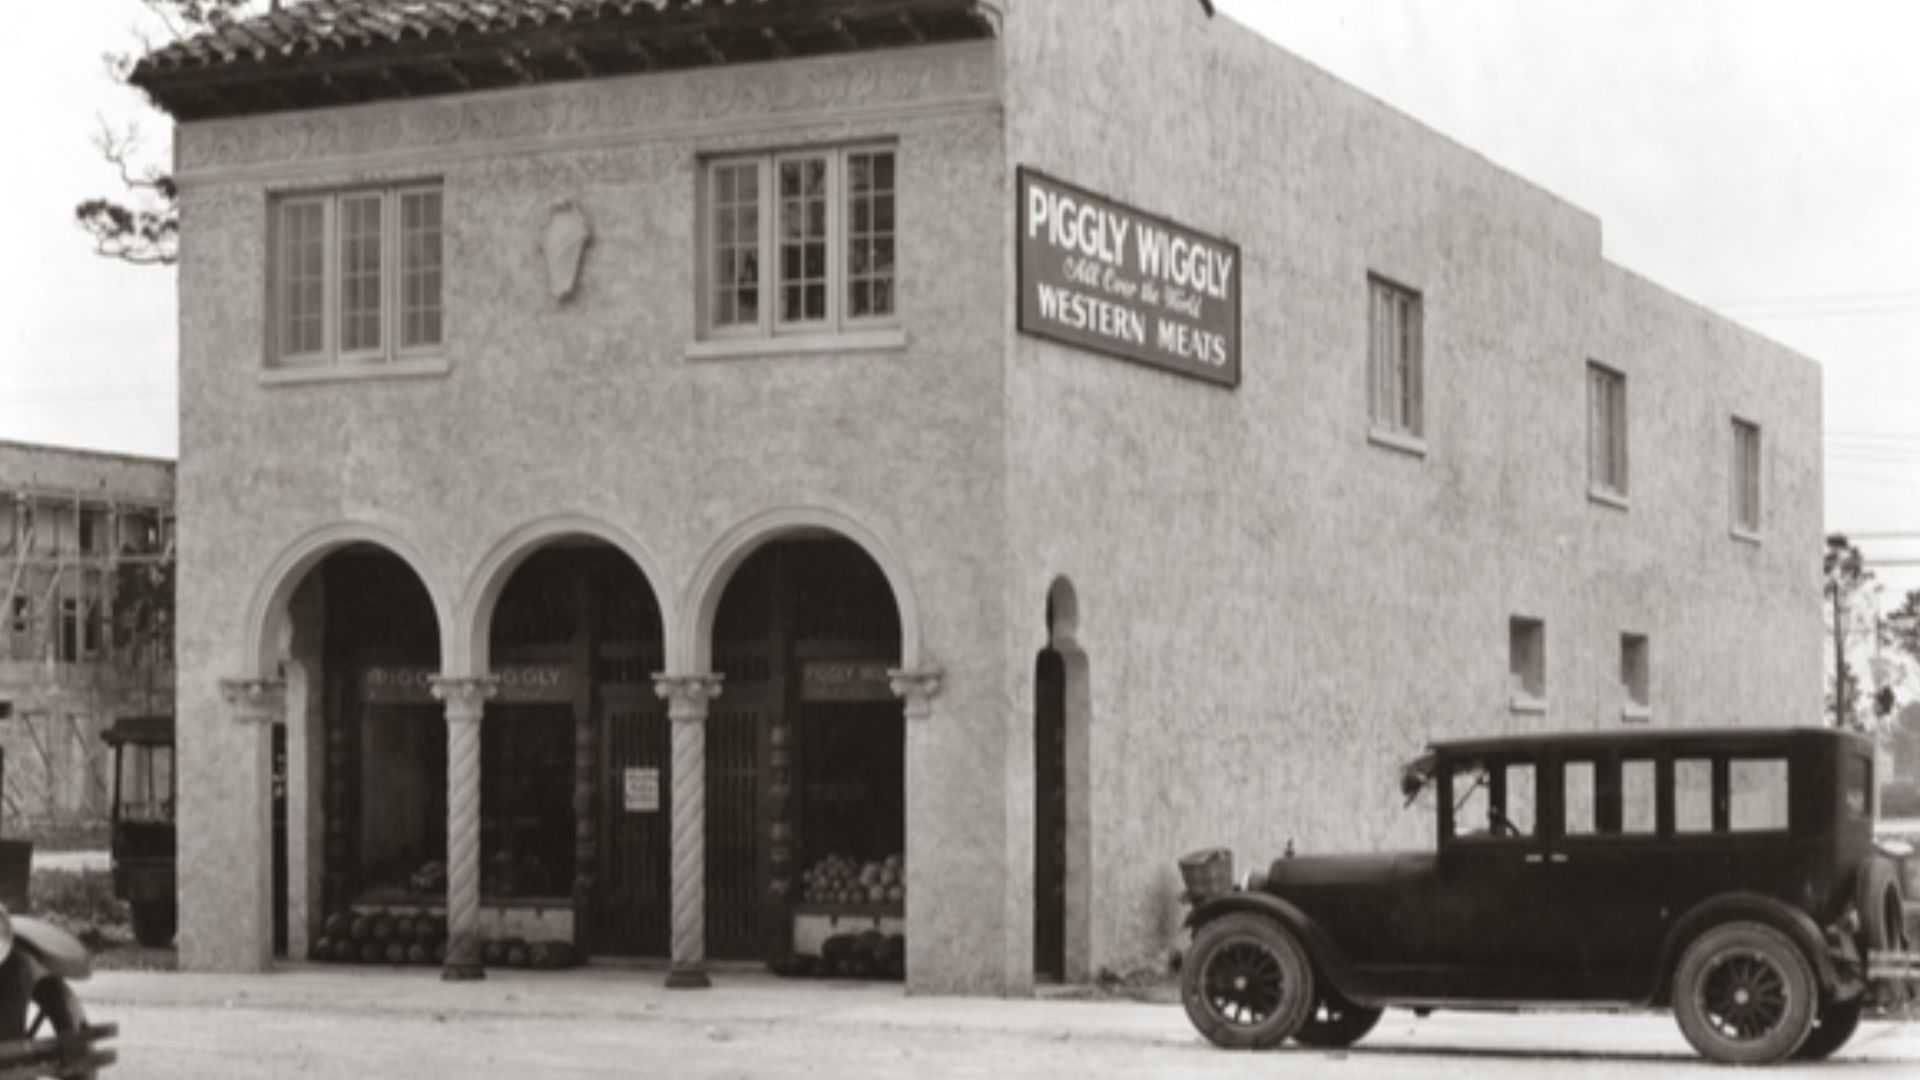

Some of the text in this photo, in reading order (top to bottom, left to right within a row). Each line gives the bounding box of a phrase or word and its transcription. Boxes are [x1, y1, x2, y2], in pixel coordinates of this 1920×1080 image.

[1028, 184, 1232, 299] PIGGLY WIGGLY
[1038, 282, 1226, 366] WESTERN MEATS
[374, 668, 561, 686] PIGG GGLY
